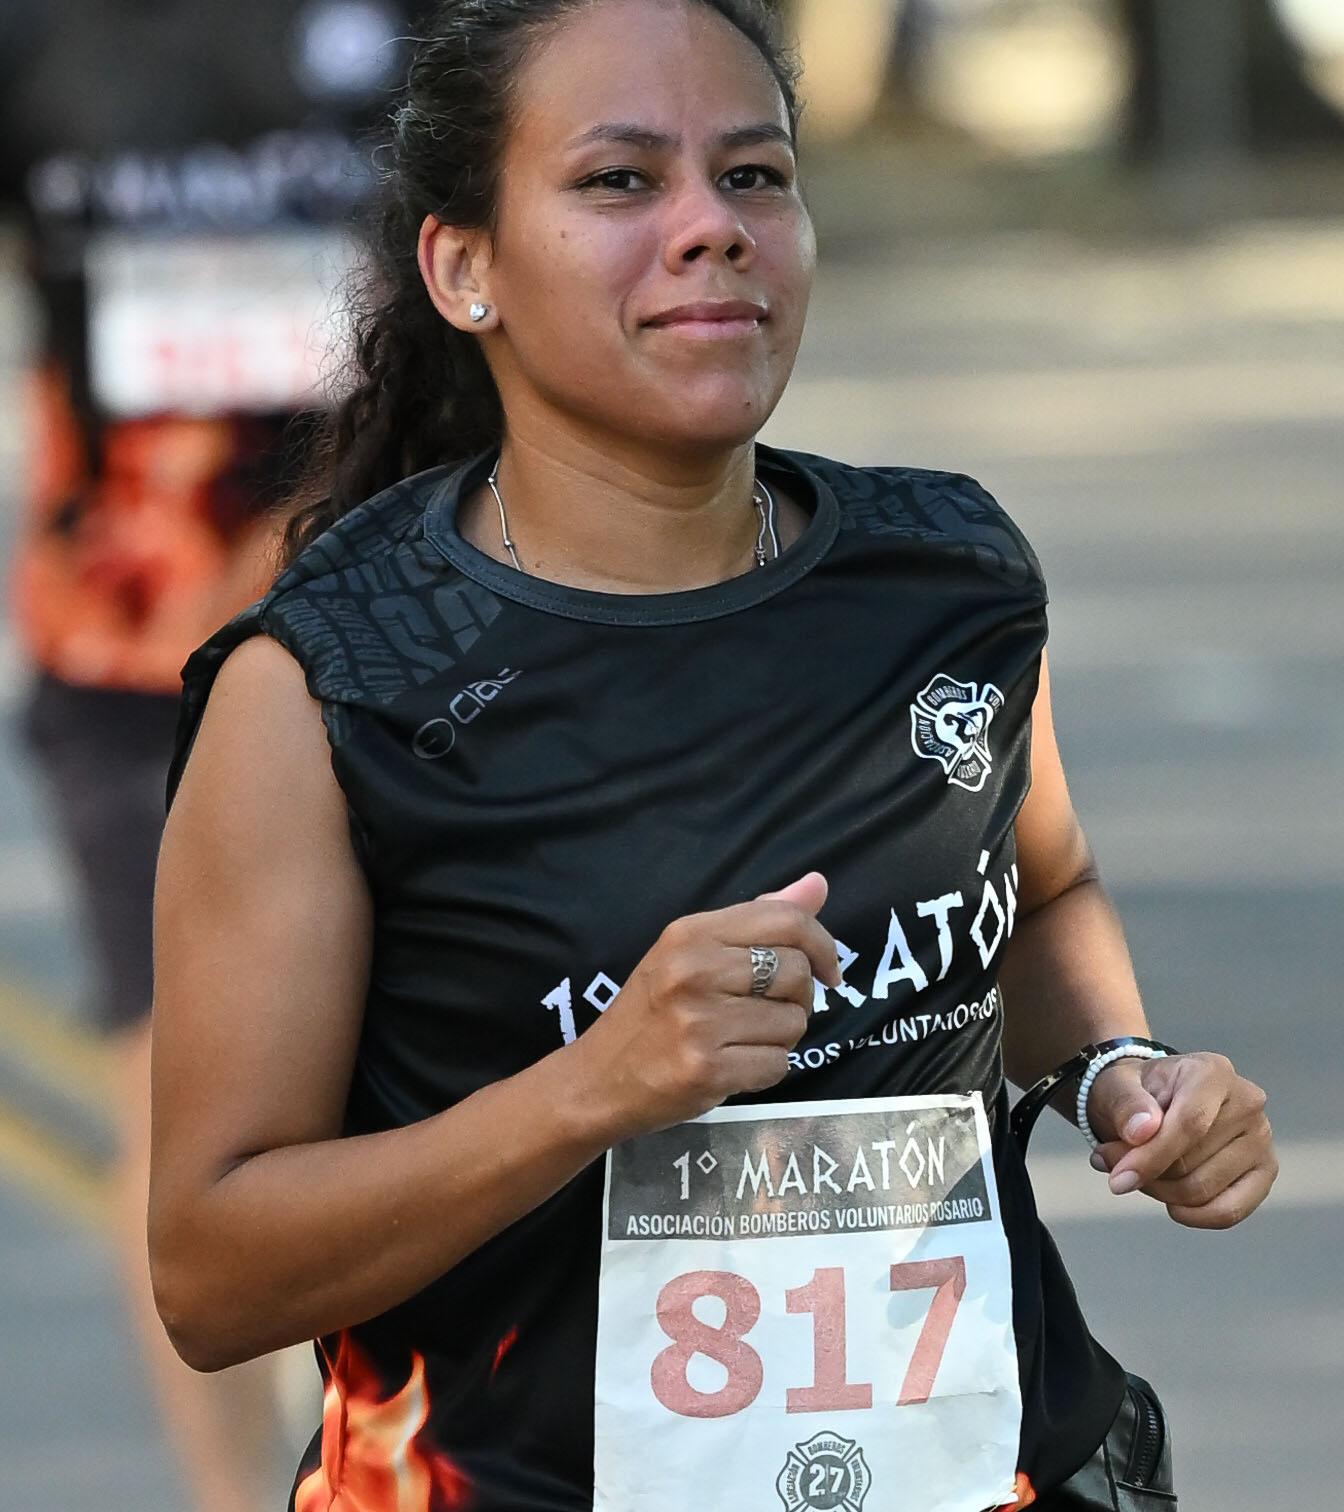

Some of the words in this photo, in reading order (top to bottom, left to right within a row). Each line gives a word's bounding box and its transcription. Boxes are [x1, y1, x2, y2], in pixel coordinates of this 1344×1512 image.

[736, 1121, 946, 1200] MARATÓN
[626, 1210, 735, 1236] ASOCIACIÓN
[739, 1209, 831, 1235] BOMBEROS
[835, 1204, 929, 1230] VOLUNTARIOS
[929, 1197, 984, 1222] ROSARIO
[651, 1256, 967, 1419] 817
[808, 1463, 845, 1497] 27
